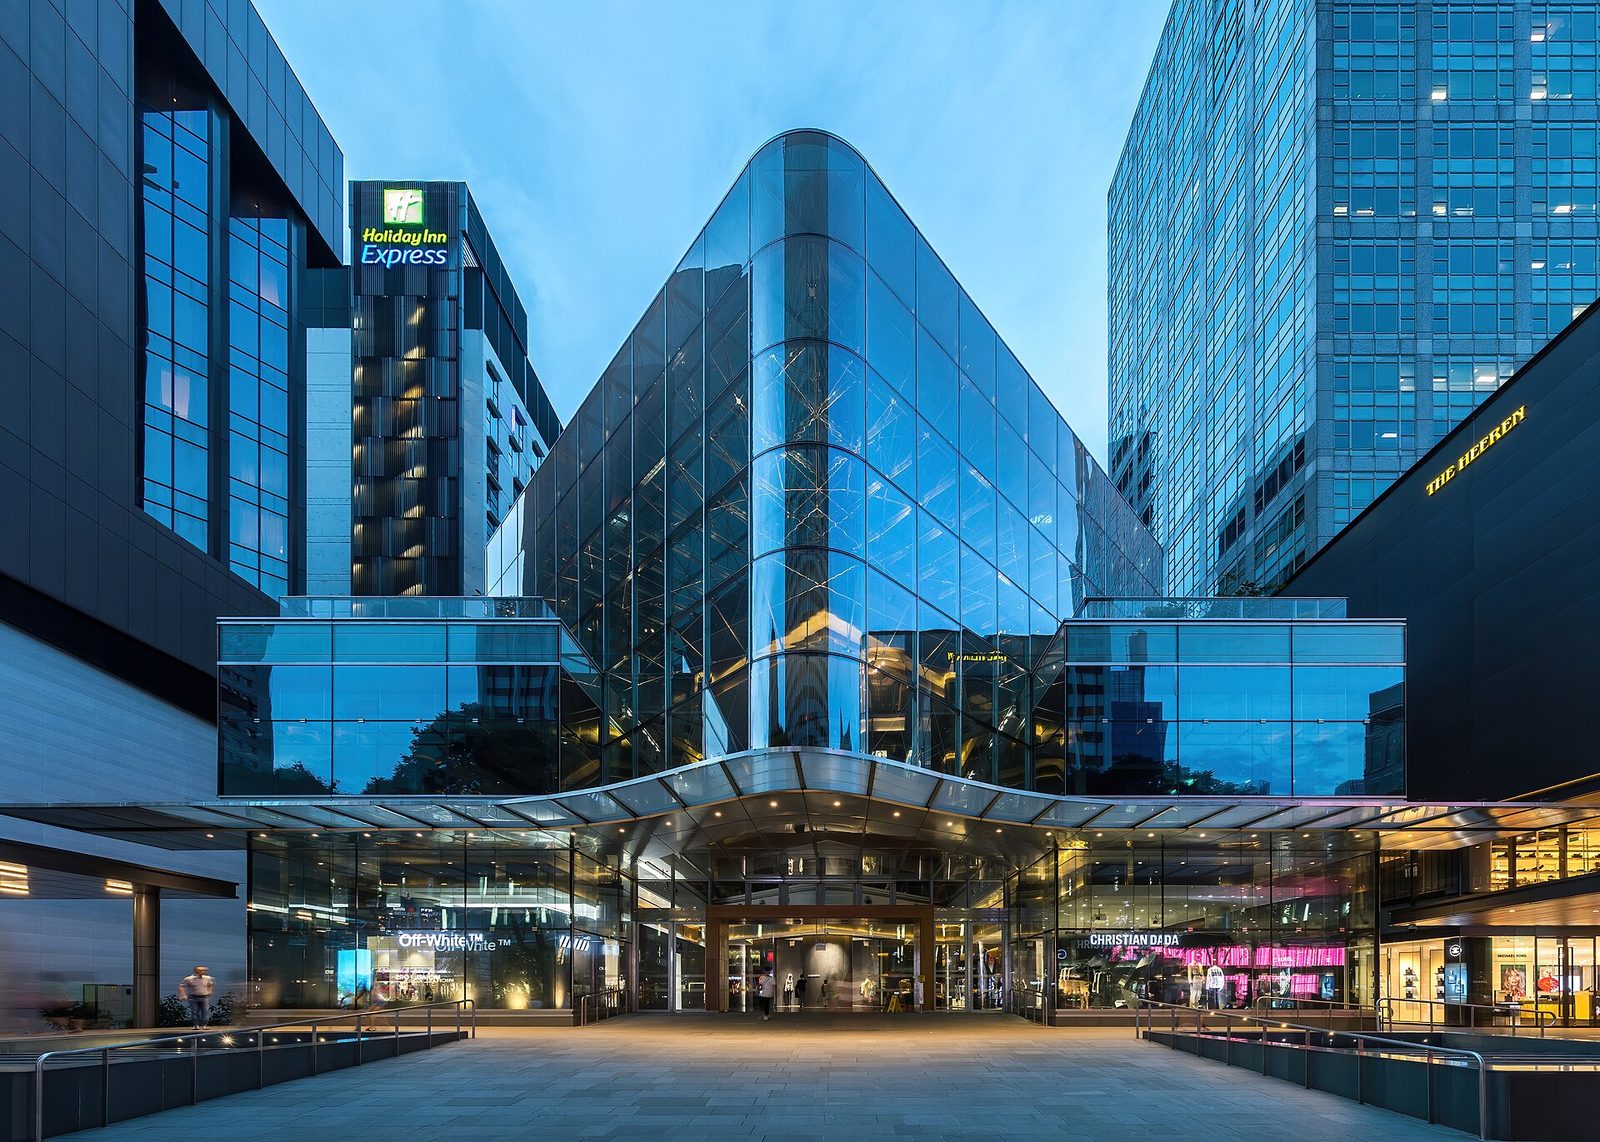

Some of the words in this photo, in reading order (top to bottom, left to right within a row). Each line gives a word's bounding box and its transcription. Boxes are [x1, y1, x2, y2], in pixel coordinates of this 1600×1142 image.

[362, 228, 421, 246] Holiday
[423, 229, 447, 243] Inn
[361, 245, 447, 269] Express
[1425, 465, 1455, 496] THE
[1458, 405, 1526, 471] HEEREN
[1090, 934, 1148, 945] CHRISTIAN
[1150, 934, 1179, 946] DADA
